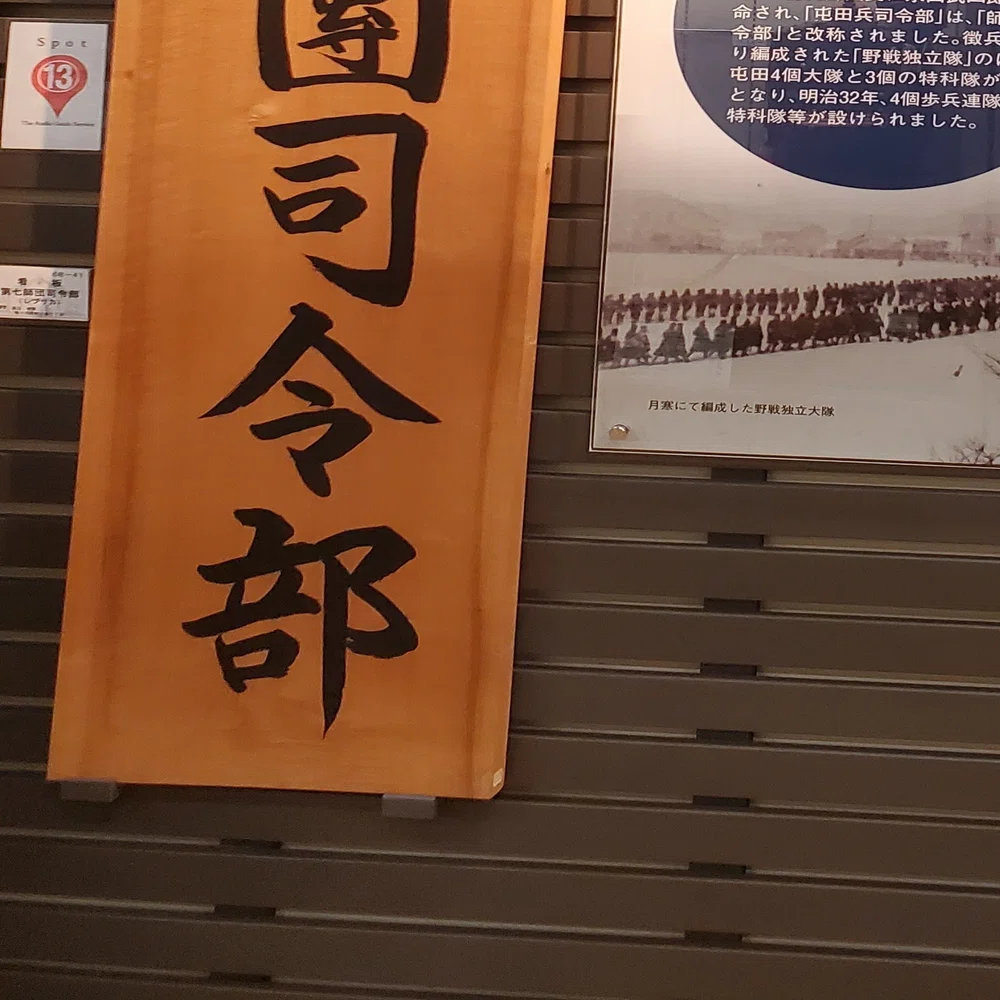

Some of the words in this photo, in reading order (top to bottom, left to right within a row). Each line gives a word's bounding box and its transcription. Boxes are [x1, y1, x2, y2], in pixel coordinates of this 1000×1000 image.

[42, 63, 73, 90] 13
[726, 107, 977, 130] 特科隊等が設けられました。
[648, 399, 835, 417] 月寒にて編成した野戦独立大隊
